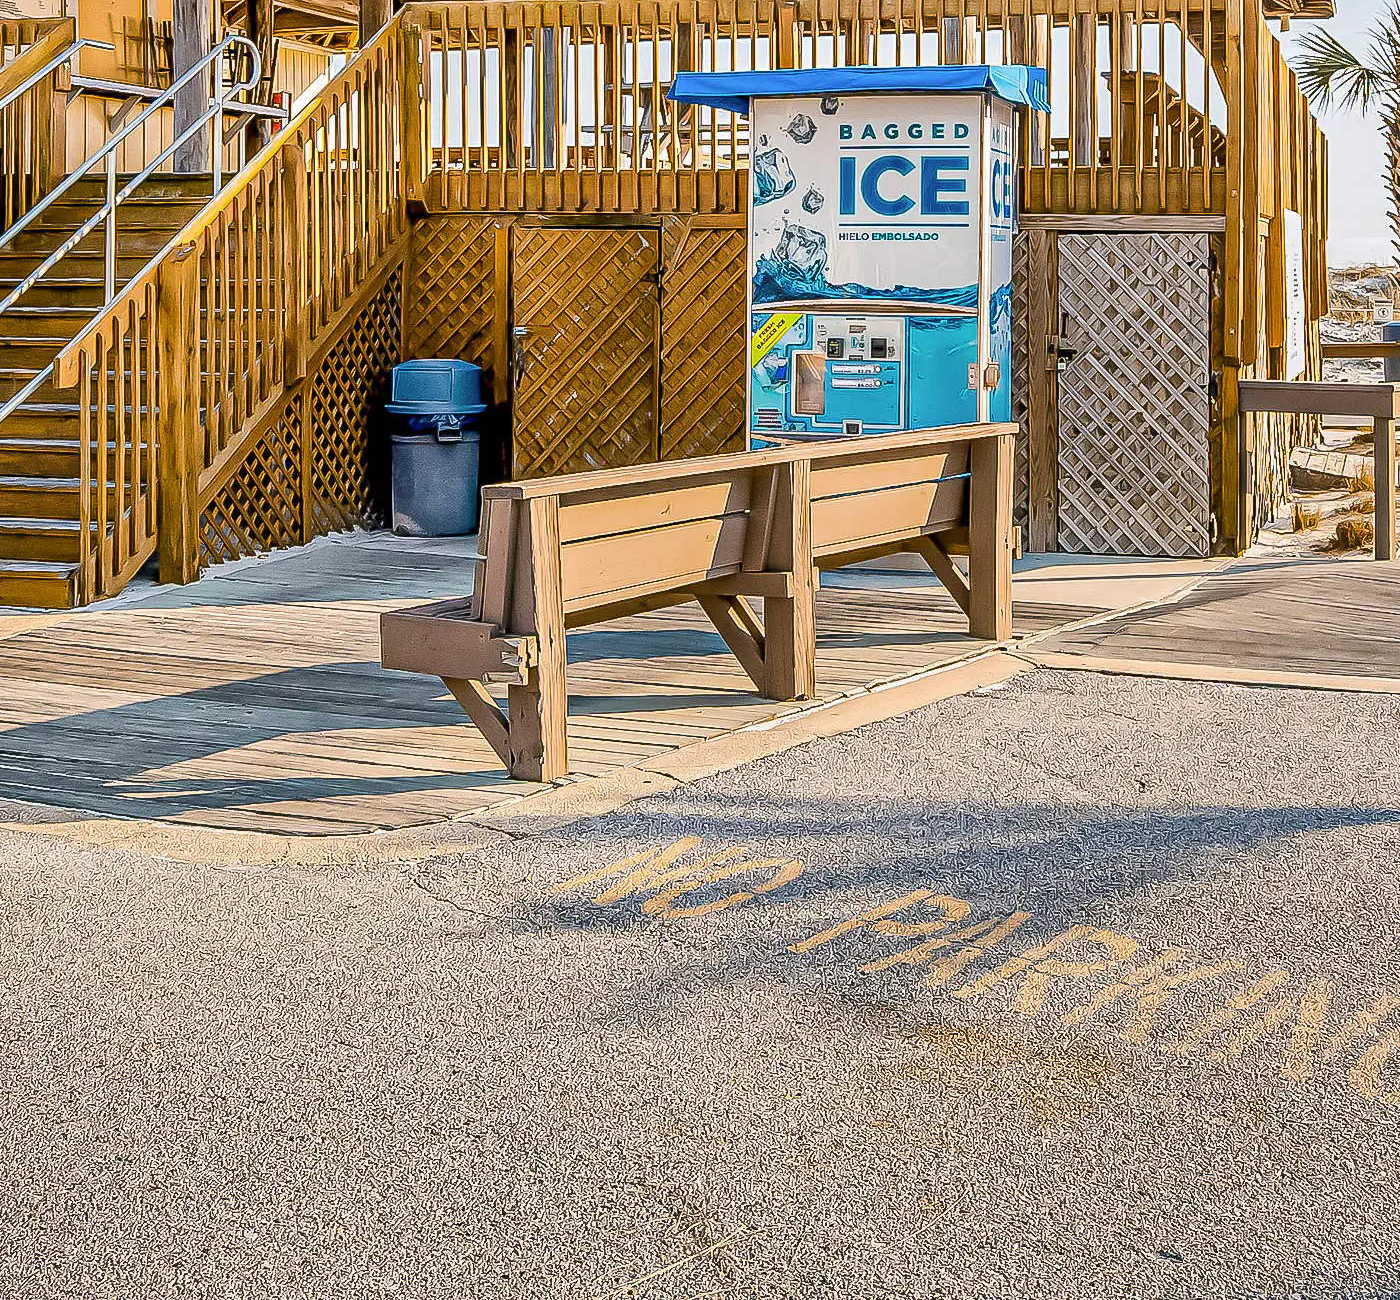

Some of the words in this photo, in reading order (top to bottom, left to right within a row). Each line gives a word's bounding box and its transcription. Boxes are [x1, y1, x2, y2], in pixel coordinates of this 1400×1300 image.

[839, 123, 970, 140] BAGGED
[839, 155, 970, 217] ICE
[992, 158, 1011, 219] CE
[838, 232, 870, 241] HIELO
[871, 232, 939, 241] EMBOLSADO
[550, 835, 804, 919] NO
